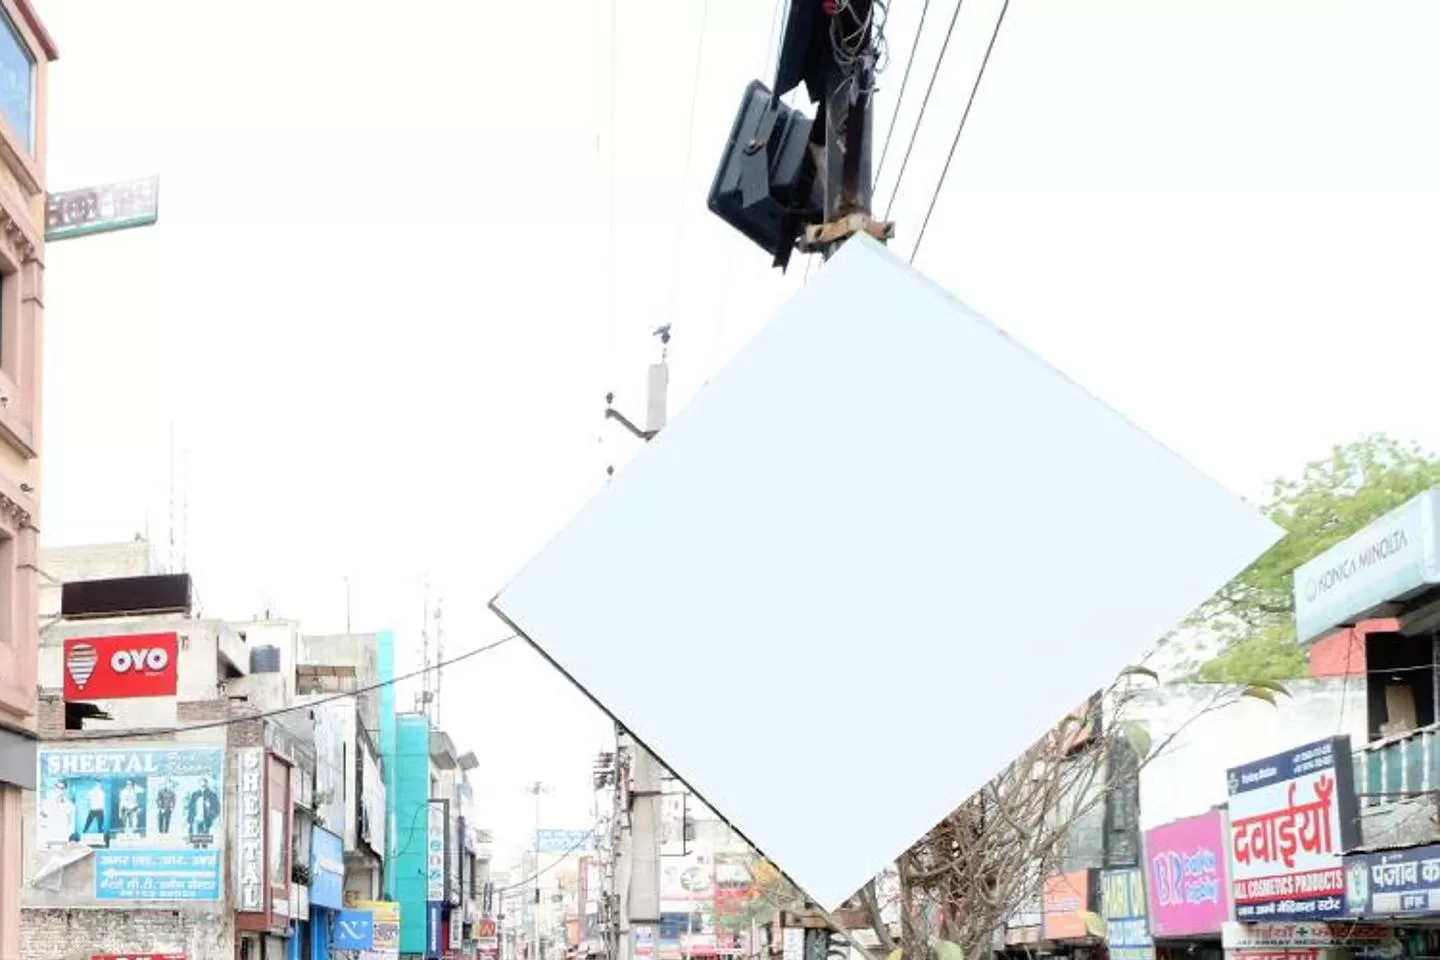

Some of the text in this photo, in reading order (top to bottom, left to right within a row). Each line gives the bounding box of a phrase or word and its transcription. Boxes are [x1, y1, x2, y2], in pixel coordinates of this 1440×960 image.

[1319, 529, 1409, 593] KONICA MINOLTA
[111, 647, 168, 673] OYO
[47, 753, 158, 773] SHEETAL
[242, 750, 260, 907] SHEETAL
[1248, 875, 1294, 898] COSMETICS
[1295, 869, 1343, 894] PRODUCTS
